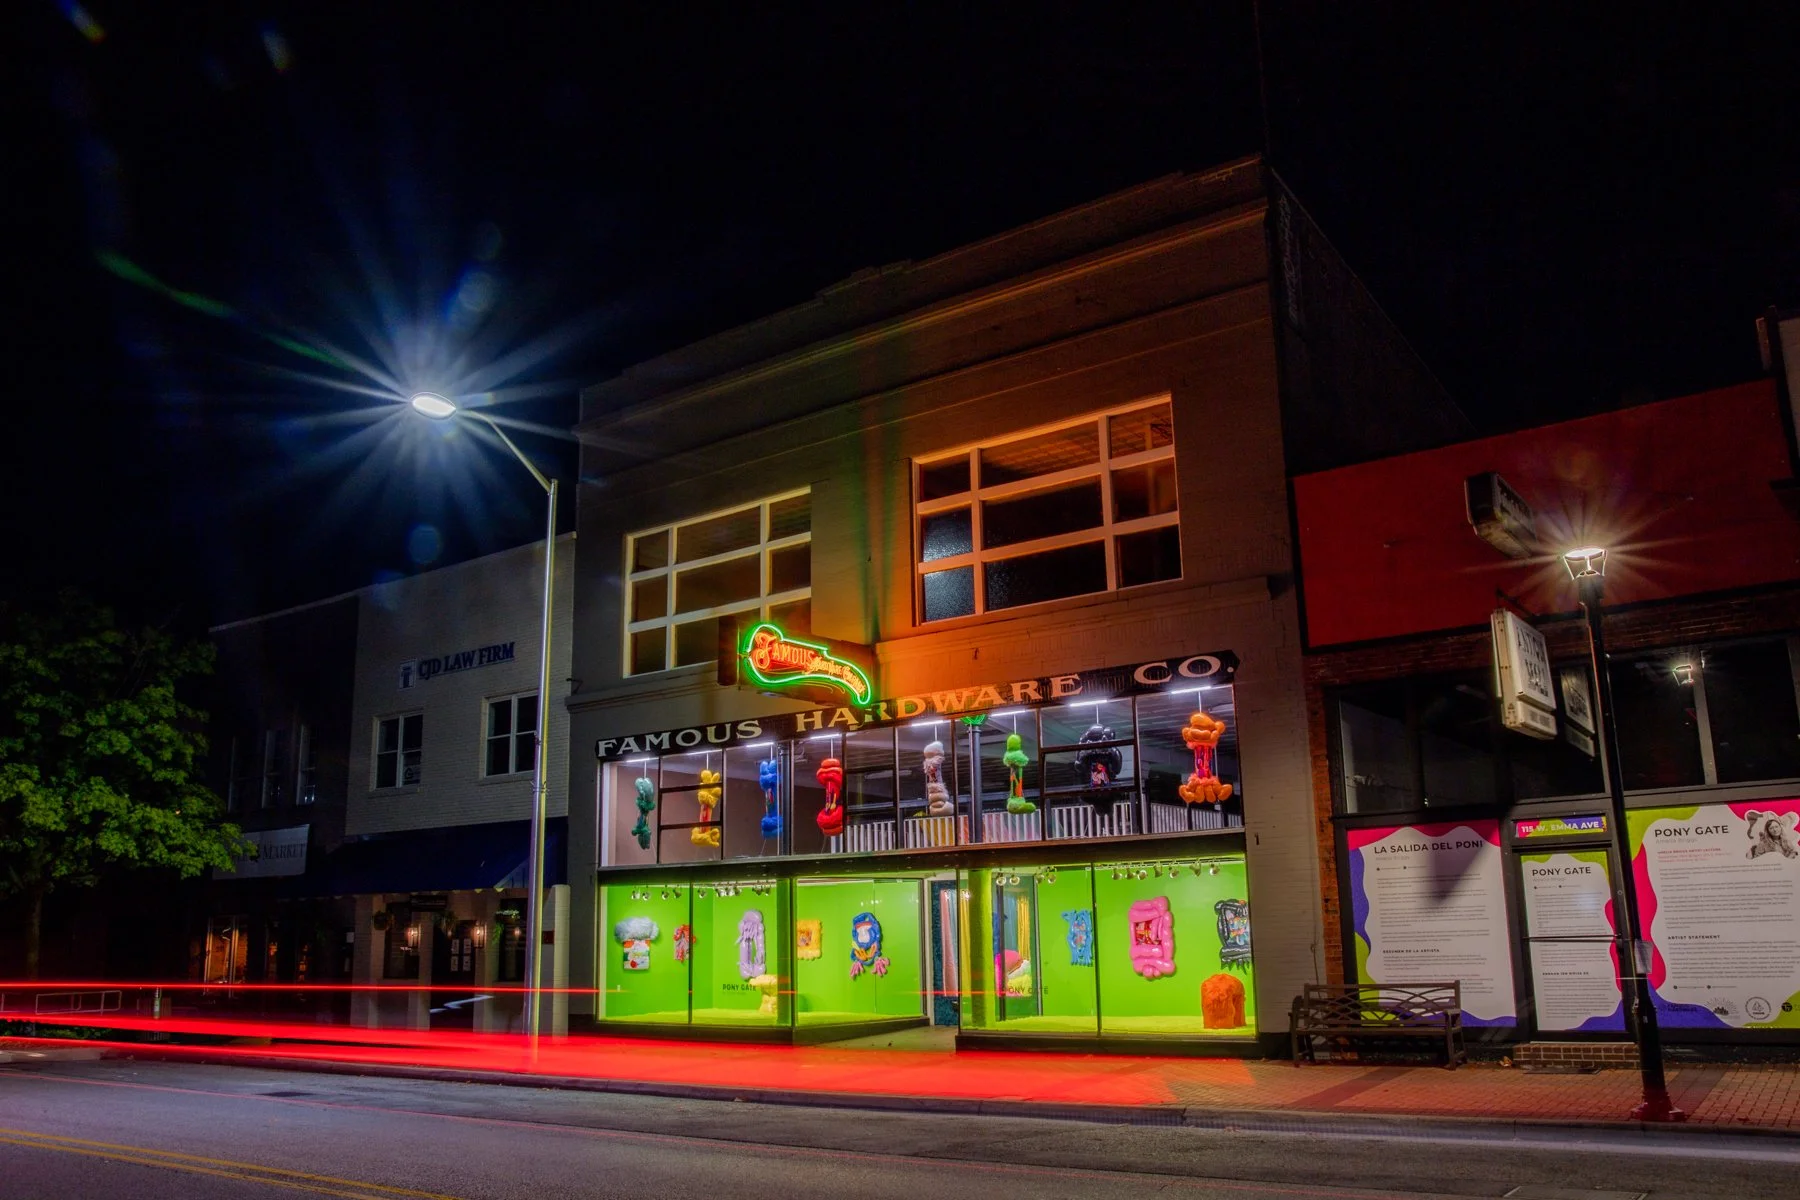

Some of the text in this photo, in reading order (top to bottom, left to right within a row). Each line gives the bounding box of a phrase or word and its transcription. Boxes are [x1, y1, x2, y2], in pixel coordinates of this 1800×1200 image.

[418, 641, 515, 681] CJD LAW FIRM
[597, 655, 1235, 758] FAMOUS HARDWARE CO.
[1521, 825, 1534, 833] 115
[1551, 823, 1579, 831] EMMA
[1580, 821, 1599, 829] AVE
[1654, 825, 1729, 838] PONY GATE
[1374, 840, 1483, 854] LA SALIDA DEL PONI
[1532, 866, 1593, 876] PONY GATE
[722, 983, 739, 991] PONY
